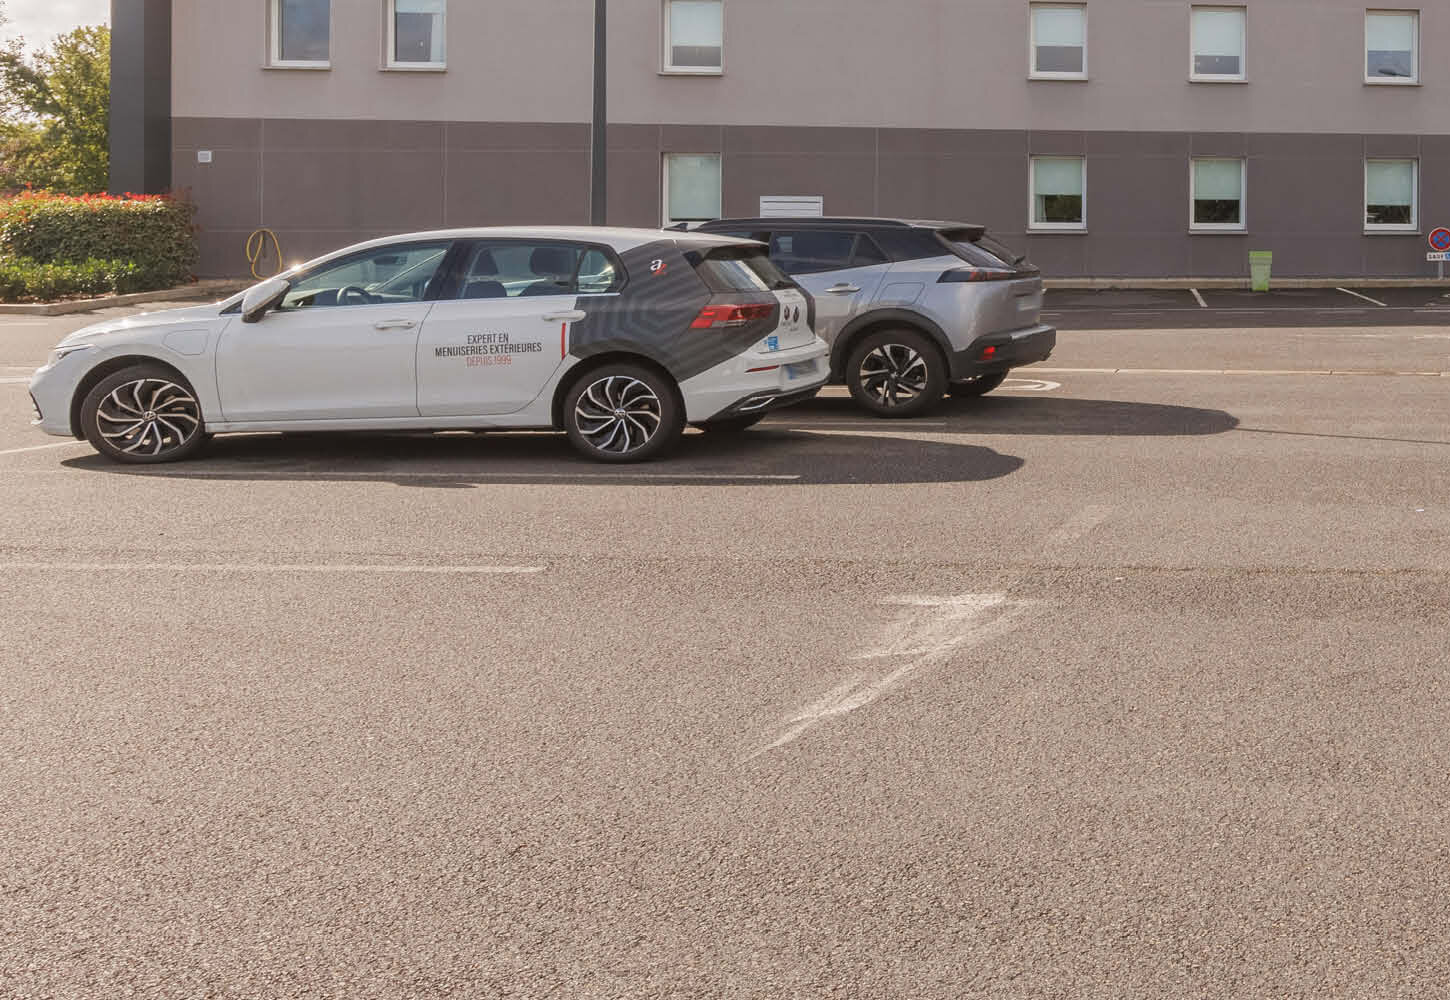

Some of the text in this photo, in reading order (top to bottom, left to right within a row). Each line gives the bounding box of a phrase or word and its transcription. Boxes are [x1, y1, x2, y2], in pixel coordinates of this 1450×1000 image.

[467, 332, 509, 345] EXPERT EN
[434, 345, 488, 357] MENUISERIES
[466, 356, 493, 368] DEPUIS
